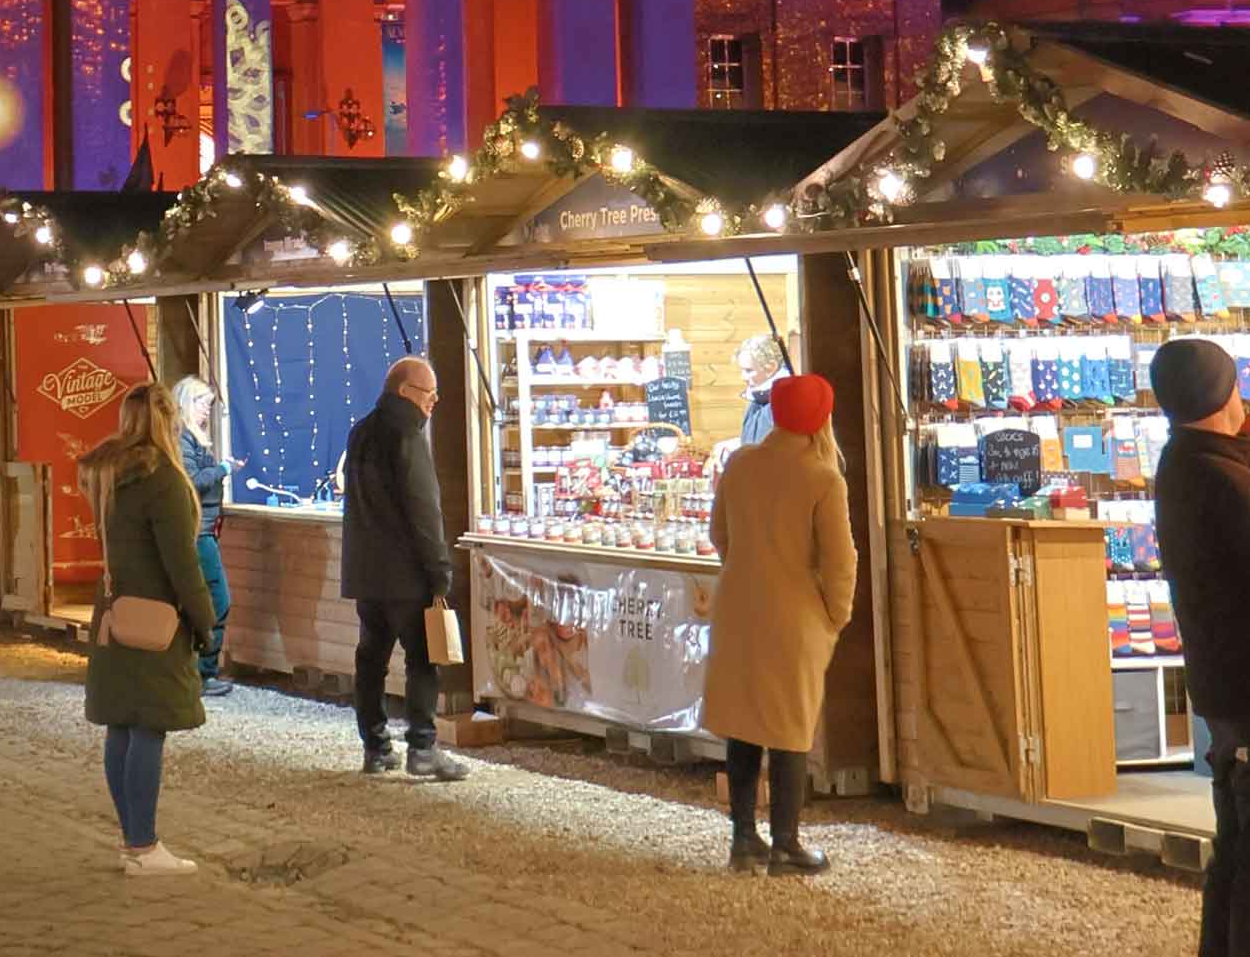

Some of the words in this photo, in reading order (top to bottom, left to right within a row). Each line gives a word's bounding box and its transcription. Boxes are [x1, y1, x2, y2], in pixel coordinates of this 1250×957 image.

[559, 210, 598, 230] Cherry
[600, 207, 627, 224] Tree
[630, 204, 657, 222] Pres
[42, 369, 117, 399] Vintage
[619, 618, 653, 641] TREE
